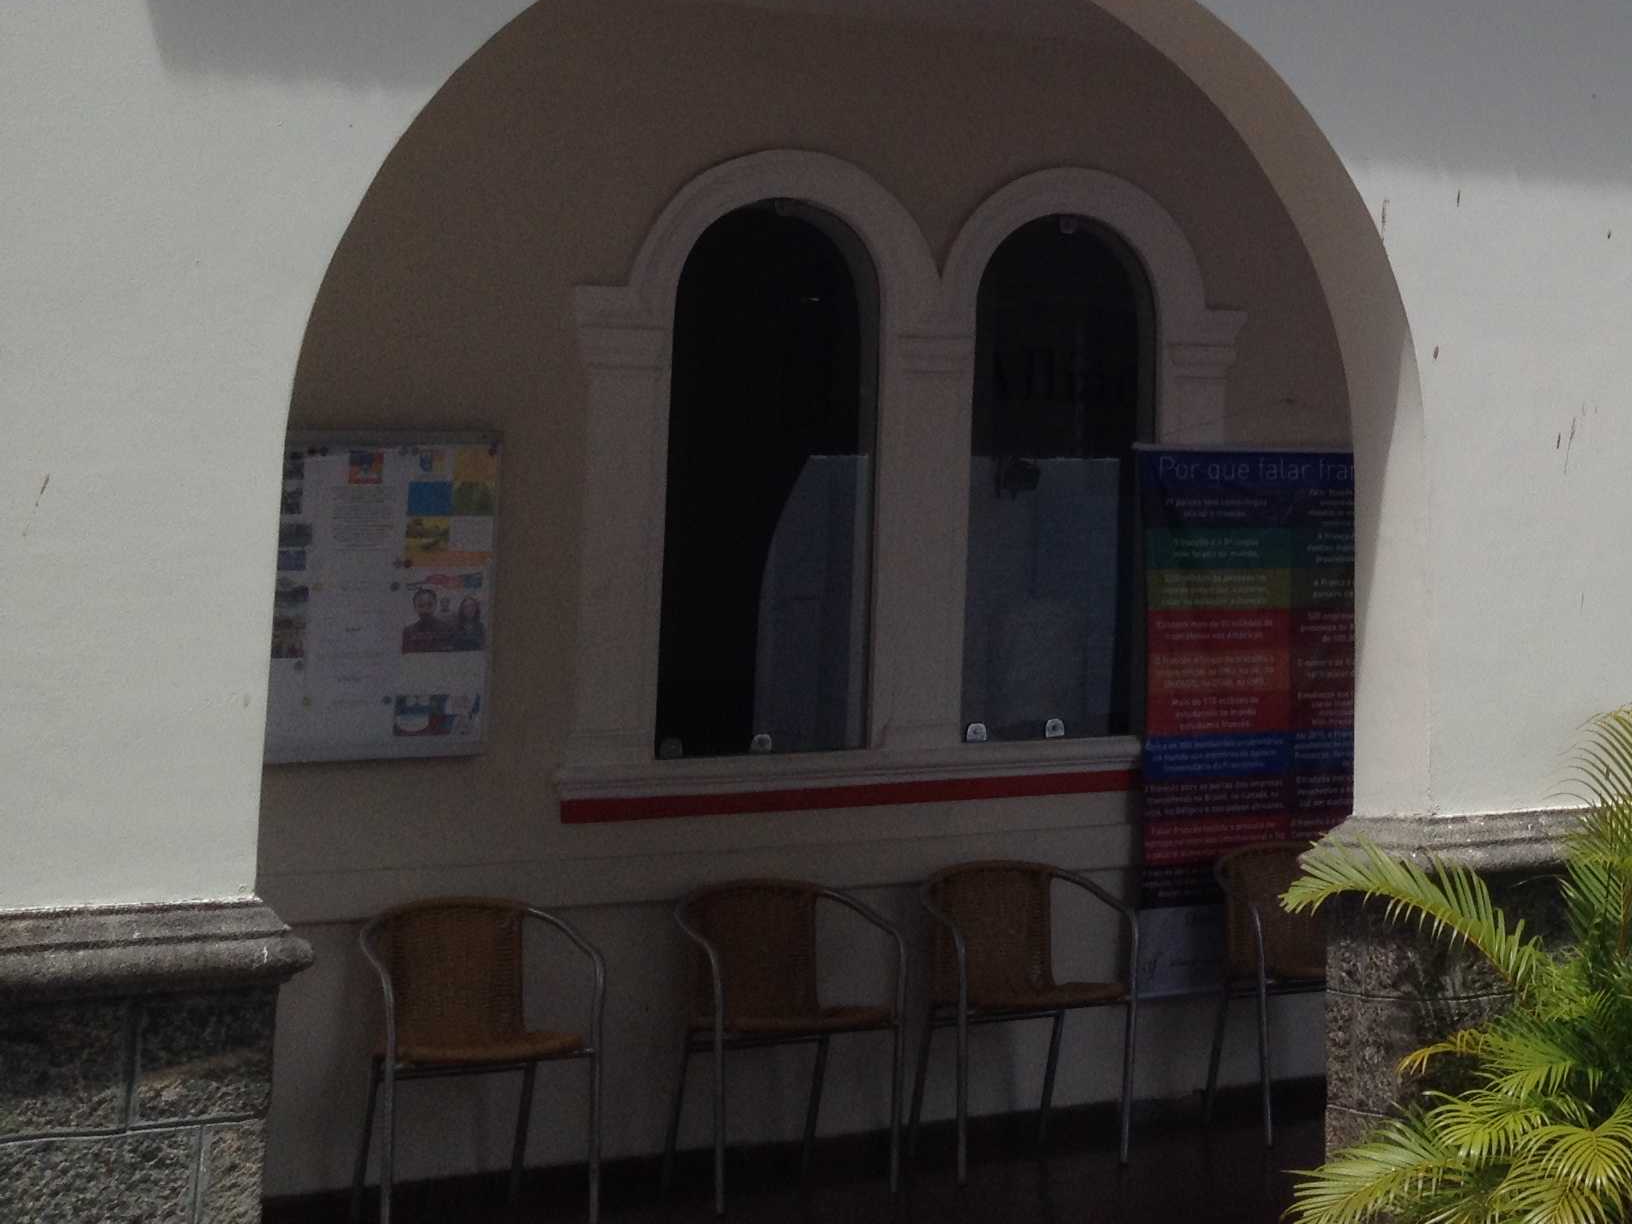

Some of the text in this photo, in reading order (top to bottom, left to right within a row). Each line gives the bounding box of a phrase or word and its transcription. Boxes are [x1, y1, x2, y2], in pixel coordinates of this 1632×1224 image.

[1159, 455, 1201, 480] Por
[1207, 462, 1250, 487] que
[1257, 456, 1313, 481] falar
